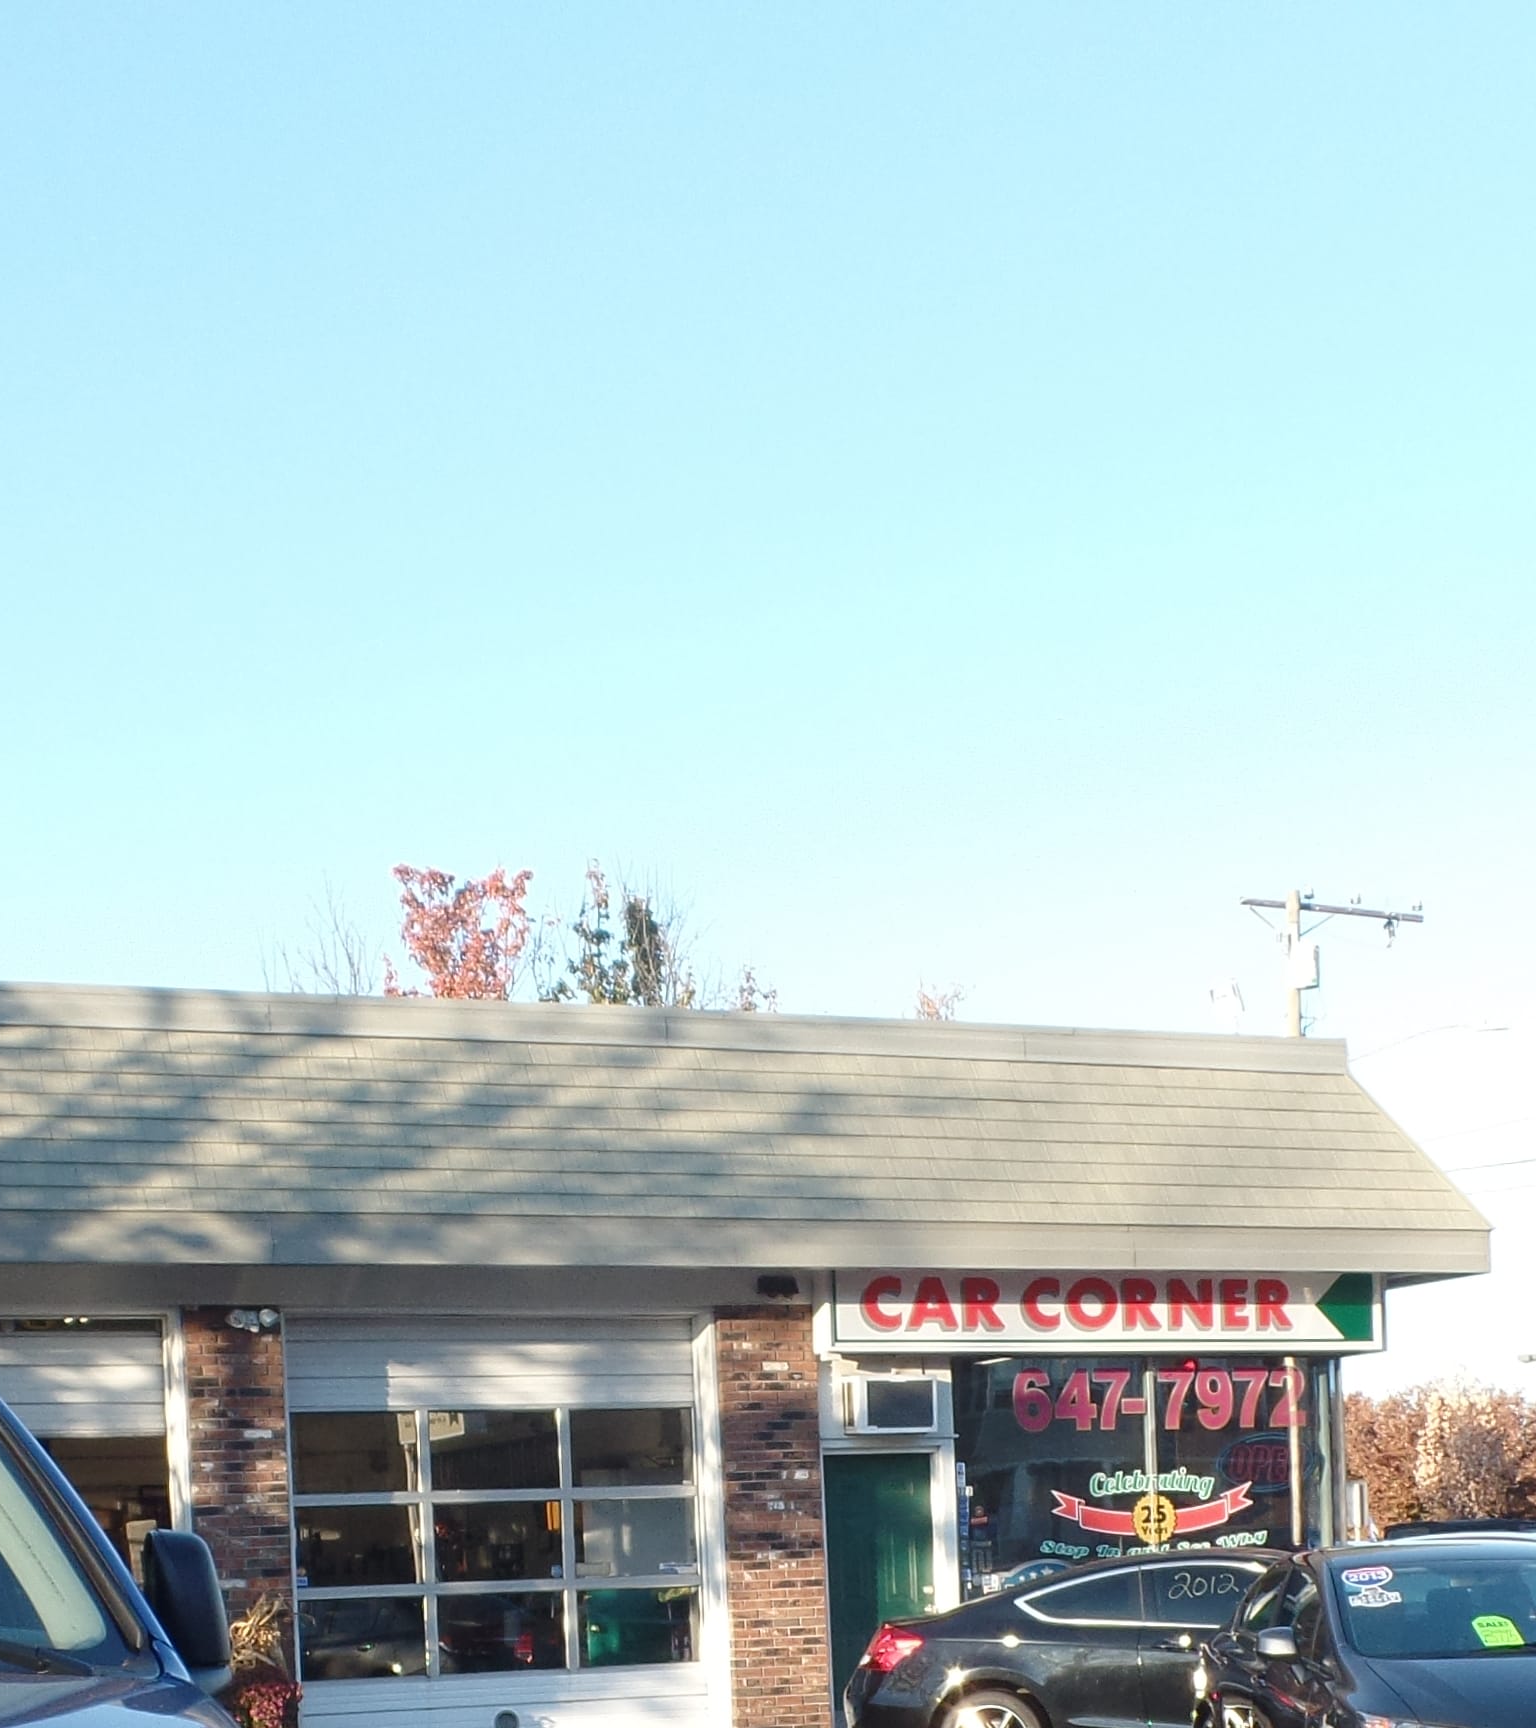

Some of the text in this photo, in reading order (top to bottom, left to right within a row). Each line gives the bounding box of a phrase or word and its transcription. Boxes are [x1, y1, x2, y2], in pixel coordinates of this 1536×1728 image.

[861, 1277, 1293, 1332] CAR CORNER
[1013, 1367, 1307, 1431] 647-7972
[1090, 1466, 1214, 1500] Celebrating
[1141, 1504, 1167, 1524] 25
[1040, 1540, 1089, 1559] Stop
